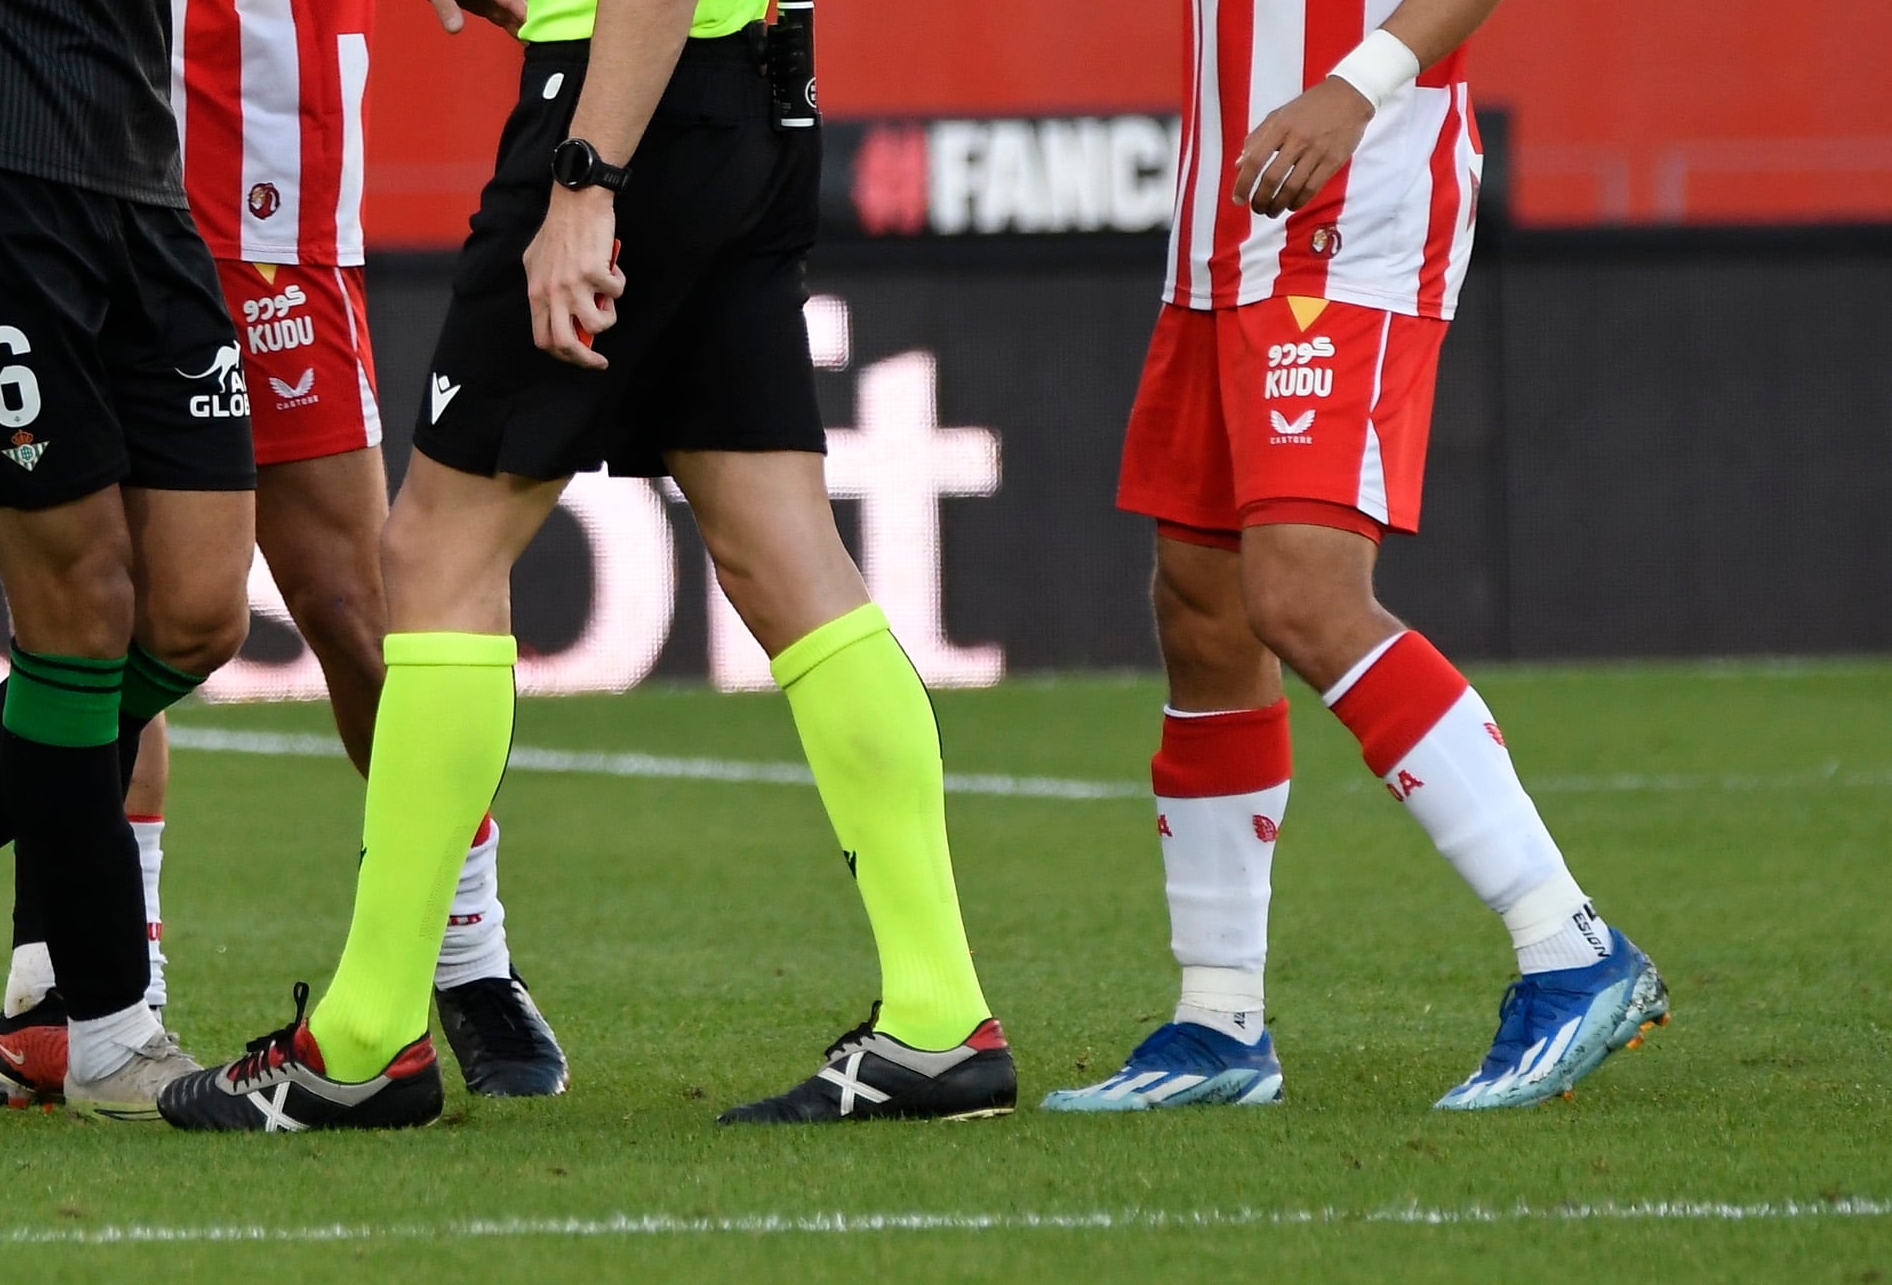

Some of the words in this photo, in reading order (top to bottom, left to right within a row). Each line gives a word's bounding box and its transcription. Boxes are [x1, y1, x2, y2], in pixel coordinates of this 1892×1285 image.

[852, 117, 1182, 235] #FANC
[247, 315, 314, 355] KUDU
[1264, 367, 1334, 400] KUDU
[1571, 910, 1611, 958] ESIGN
